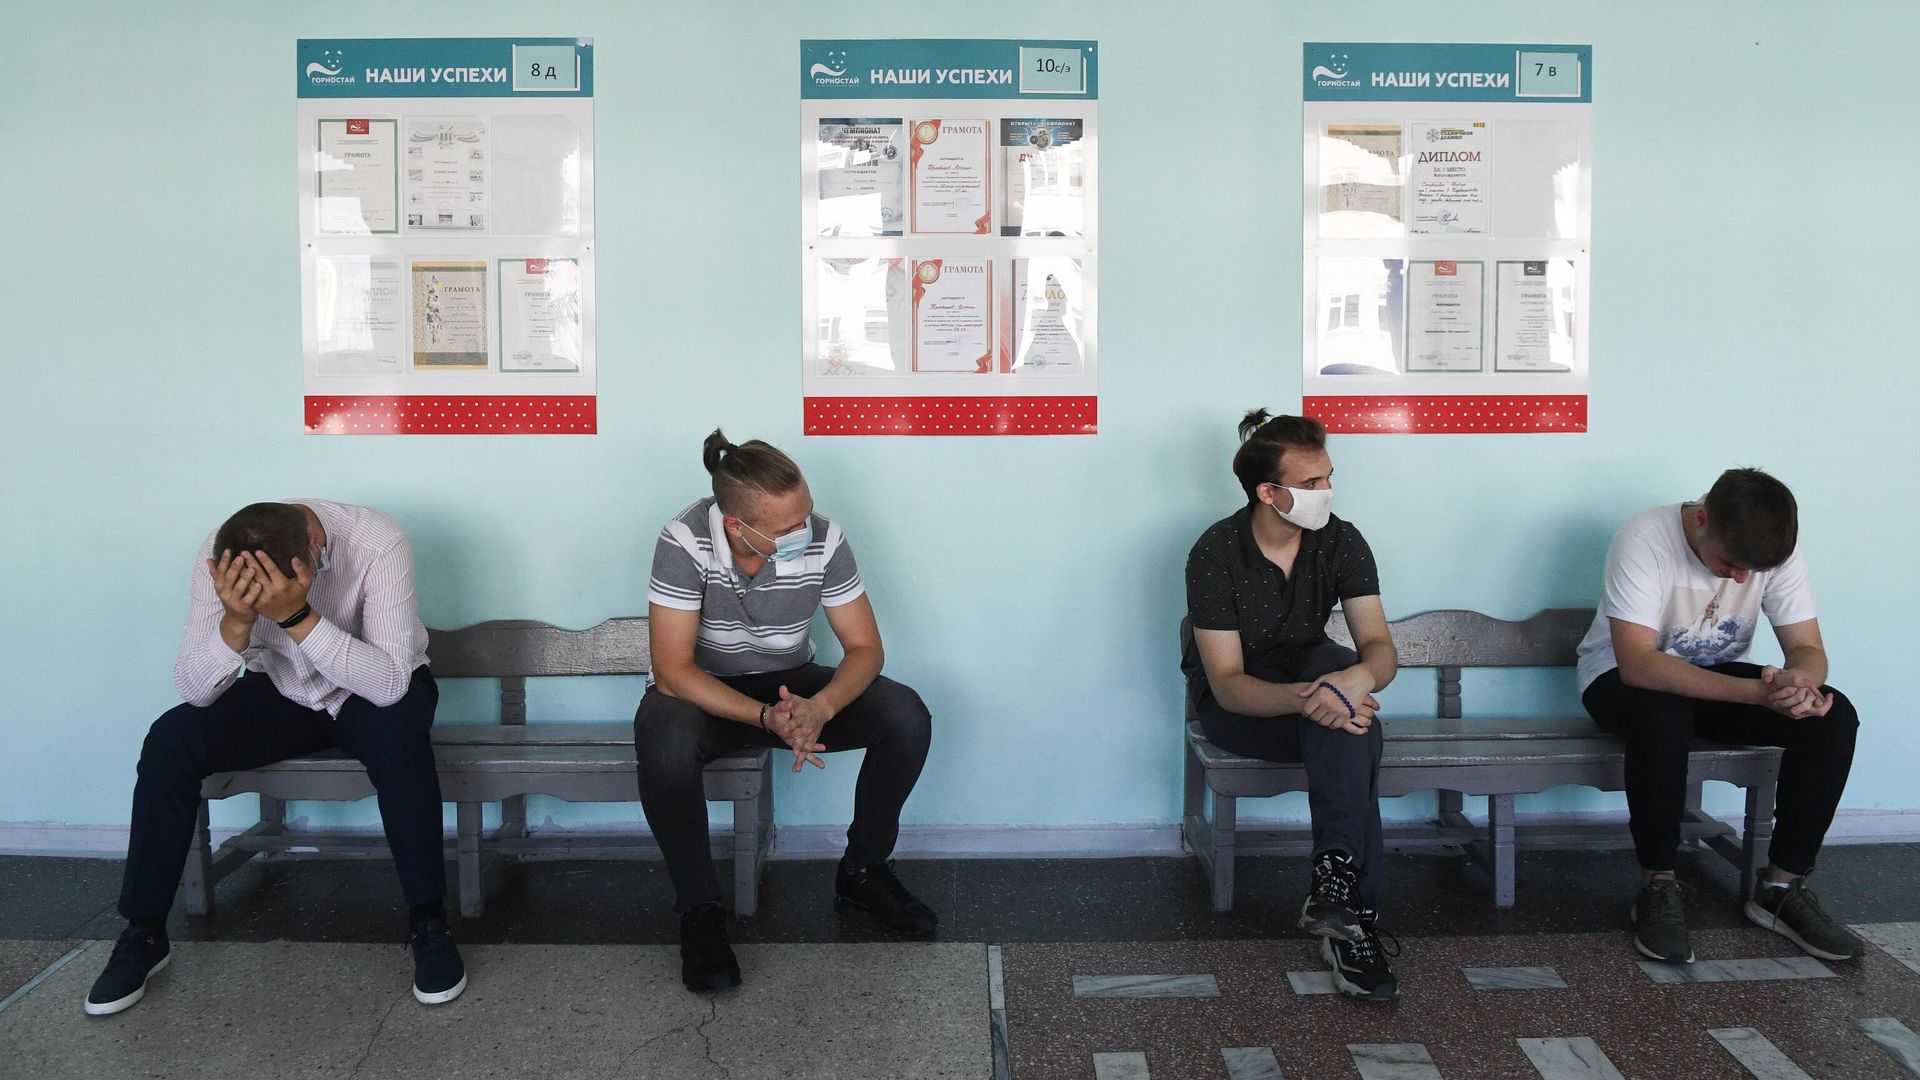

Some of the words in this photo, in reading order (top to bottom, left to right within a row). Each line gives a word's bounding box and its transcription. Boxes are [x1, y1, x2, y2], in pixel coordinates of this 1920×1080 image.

[366, 68, 425, 83] НАШИ
[430, 67, 507, 83] УСПЕХИ
[531, 62, 541, 77] 8
[545, 66, 556, 80] д
[870, 68, 931, 84] НАШИ
[935, 69, 1012, 84] УСПЕХИ
[1535, 63, 1544, 76] 7
[1548, 66, 1557, 77] в
[311, 76, 355, 84] ГОРНОСТАЙ
[815, 76, 860, 85] ГОРНОСТАЙ
[1317, 79, 1361, 87] ГОРНОСТАЙ
[1371, 72, 1430, 87] НАШИ
[1435, 72, 1510, 88] УСПЕХИ
[942, 126, 982, 134] ГРАМОТА
[1417, 151, 1482, 164] ДИПЛОМ
[944, 265, 984, 274] ГРАМОТА
